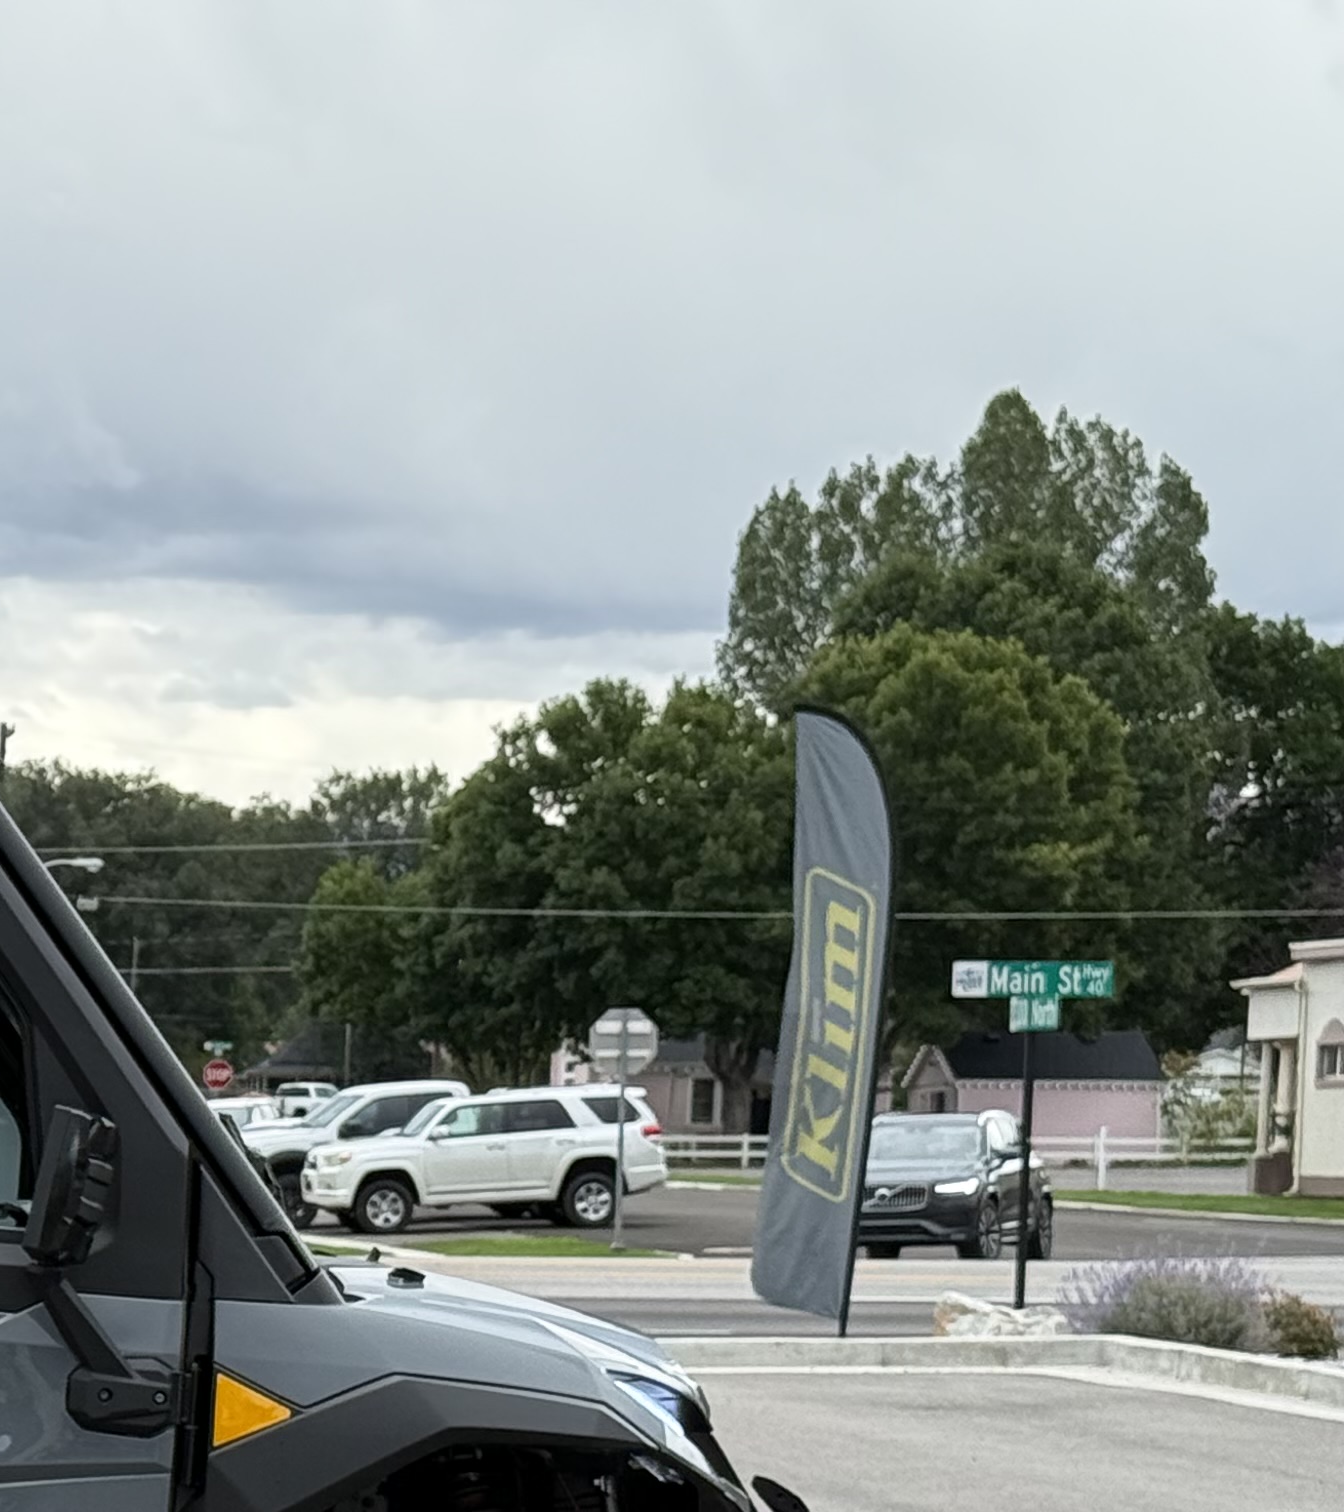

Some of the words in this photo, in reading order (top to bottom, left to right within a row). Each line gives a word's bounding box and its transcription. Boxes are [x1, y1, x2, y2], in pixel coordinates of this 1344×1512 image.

[990, 964, 1045, 995] Main
[1058, 964, 1082, 995] St
[1082, 963, 1109, 984] Hwy
[1086, 980, 1104, 997] 40
[206, 1067, 230, 1081] STOP
